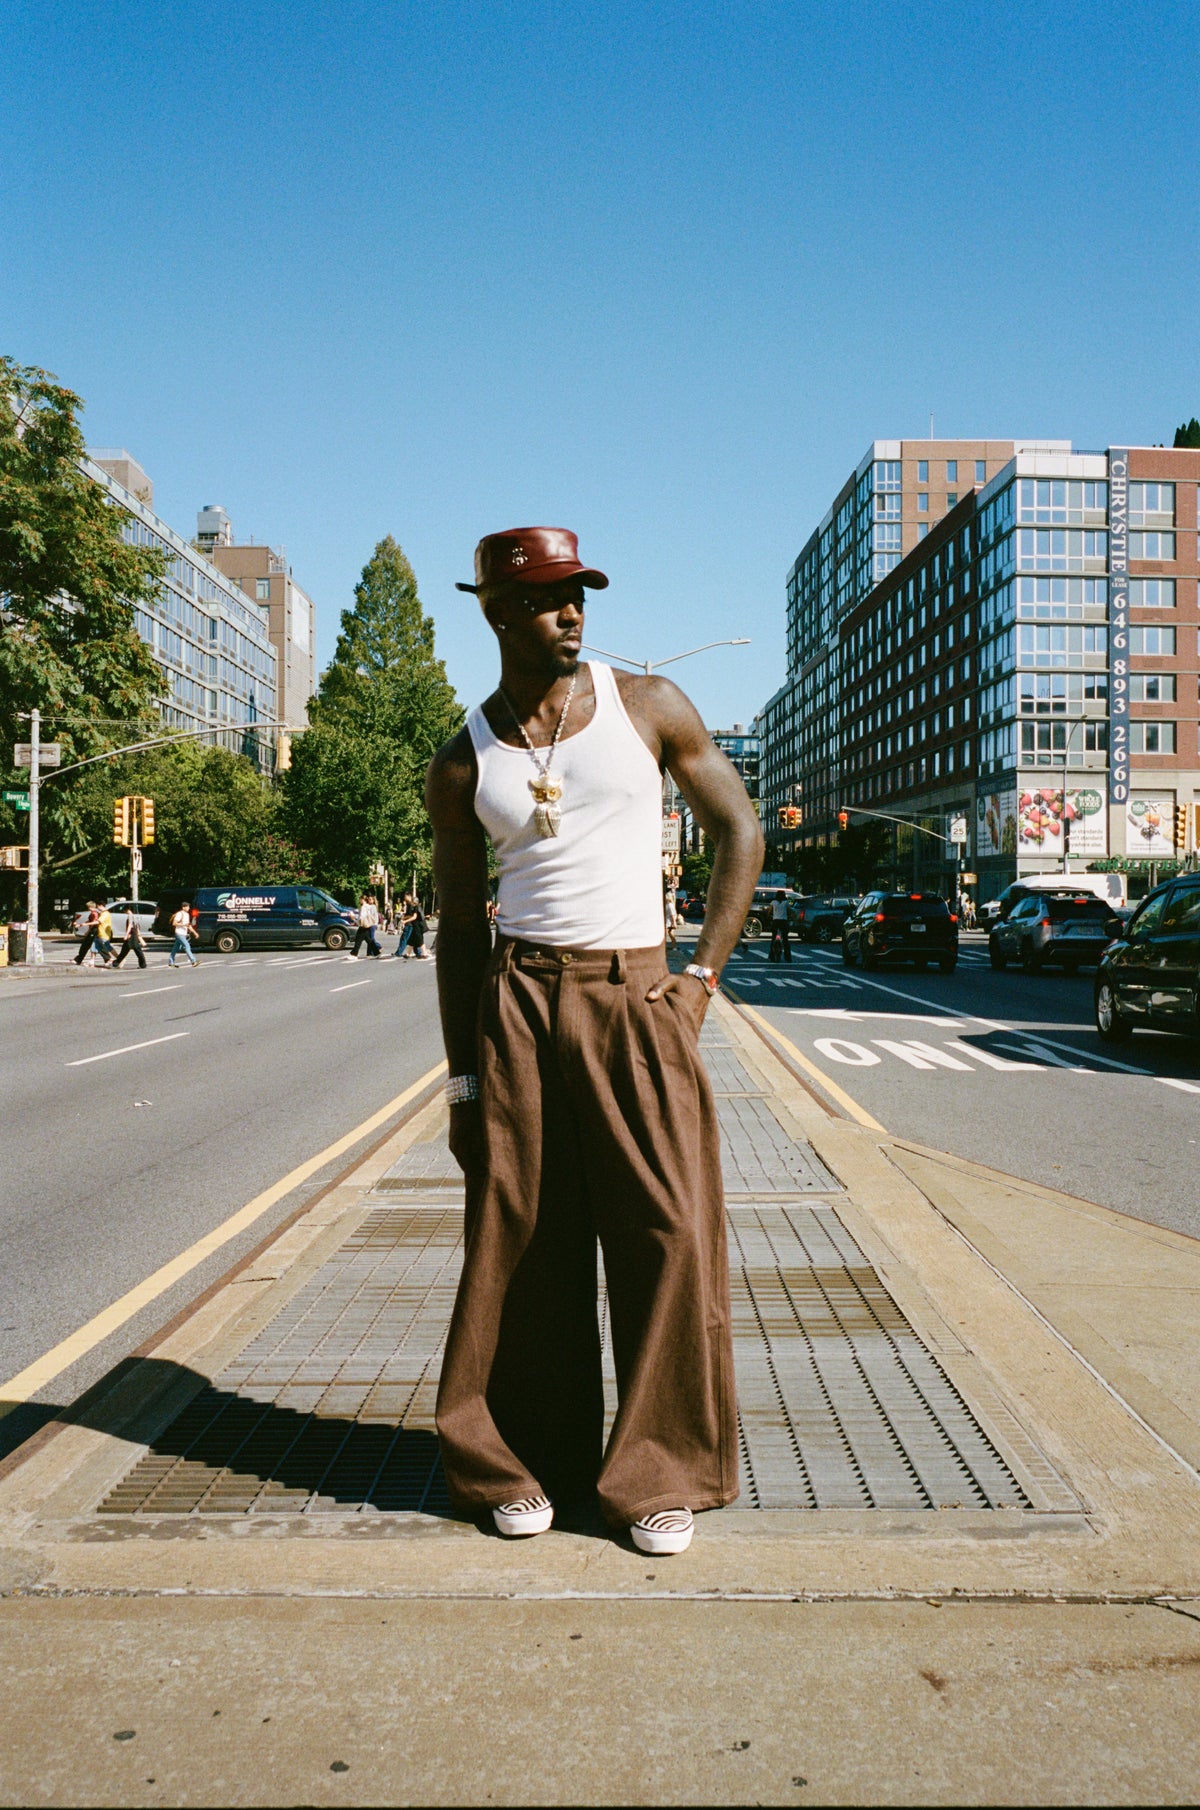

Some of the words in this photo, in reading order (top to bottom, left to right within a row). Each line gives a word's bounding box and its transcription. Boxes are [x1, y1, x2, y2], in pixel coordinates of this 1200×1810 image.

[1111, 460, 1127, 572] CHRYSTIE
[1113, 592, 1126, 649] 646
[1113, 659, 1126, 714] 893
[1113, 726, 1126, 800] 2660
[1096, 859, 1139, 871] WHOLE
[727, 977, 863, 989] ONLY
[813, 1037, 1097, 1074] ONLY
